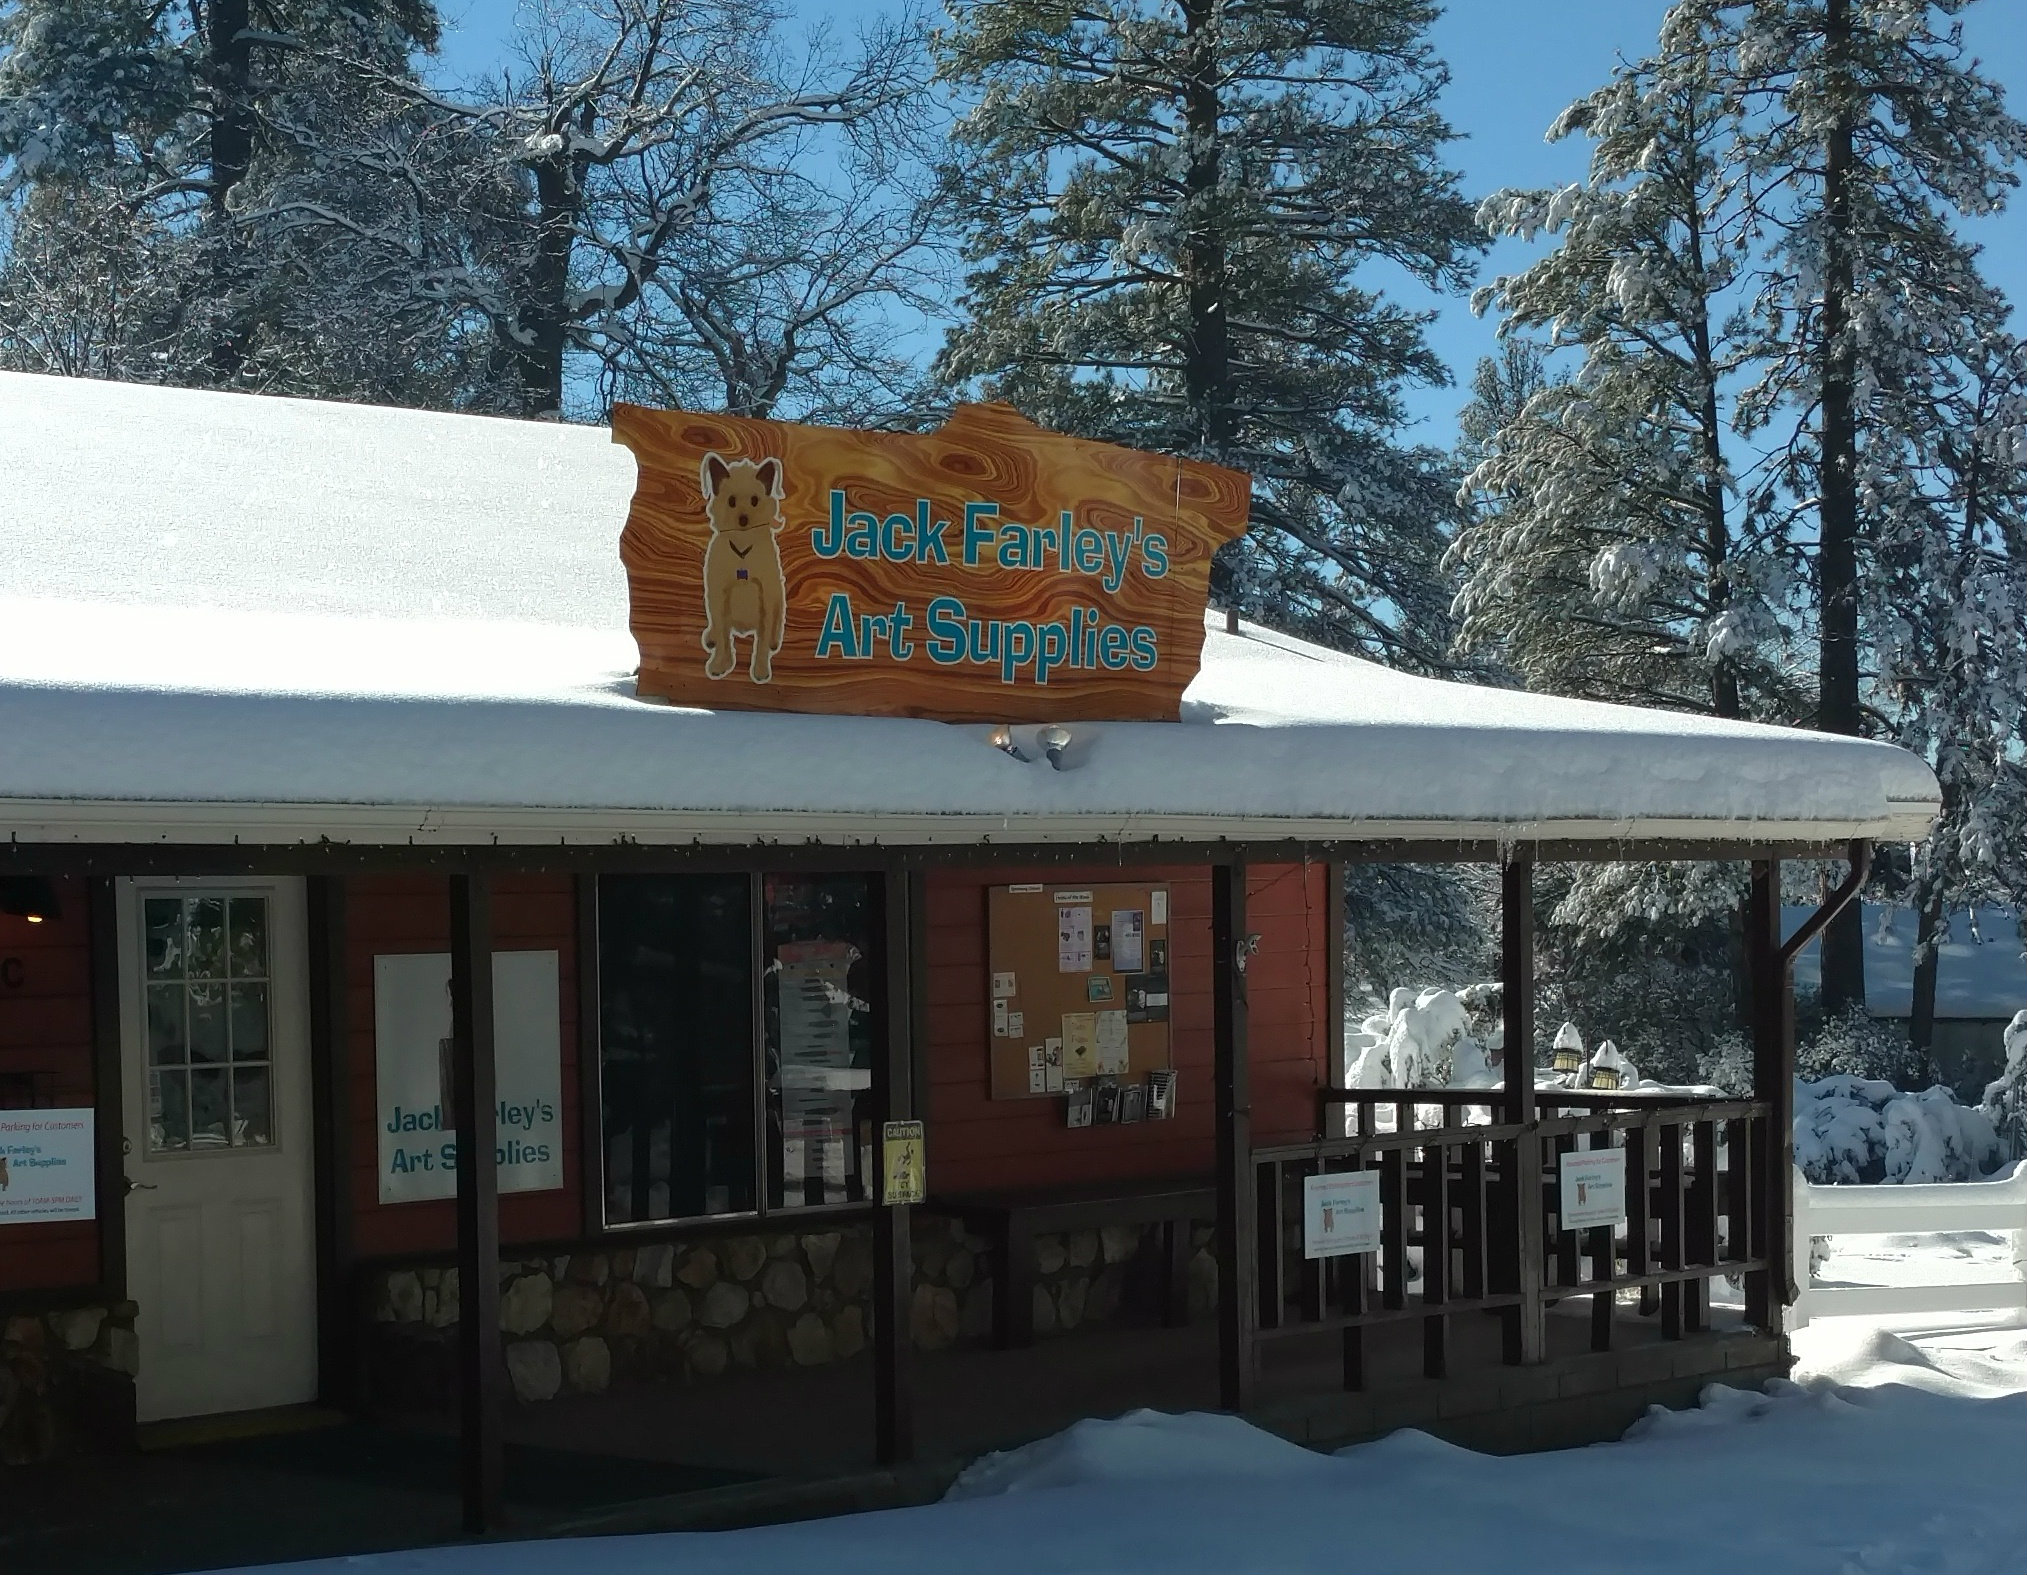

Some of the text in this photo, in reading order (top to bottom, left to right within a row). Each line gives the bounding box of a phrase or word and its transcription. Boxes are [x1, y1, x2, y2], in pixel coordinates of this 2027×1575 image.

[811, 488, 1170, 594] Jack Farley's
[814, 592, 1158, 685] Art Supplies
[391, 1140, 550, 1174] Art Slies
[887, 1126, 920, 1138] CAUTION
